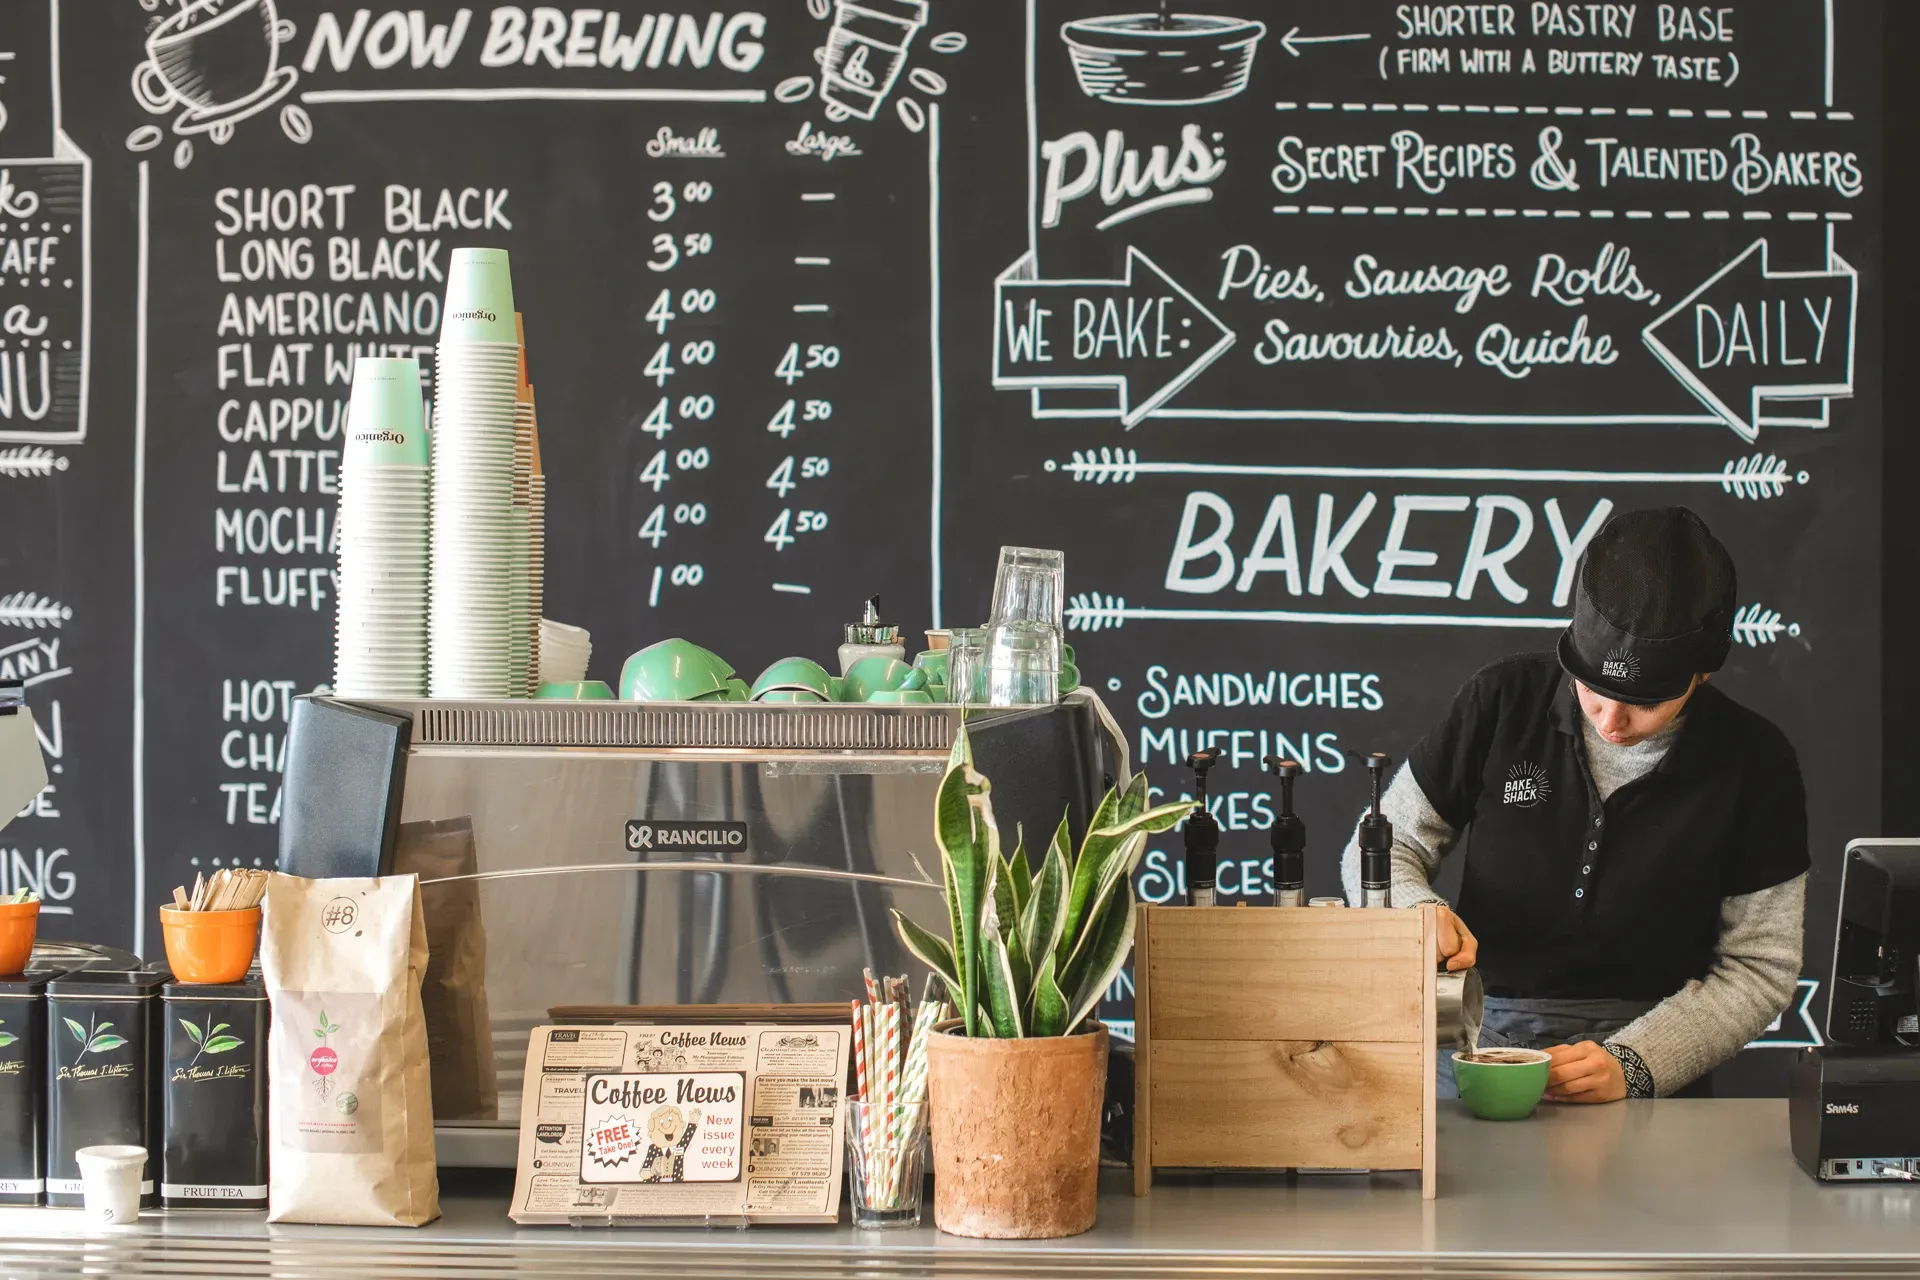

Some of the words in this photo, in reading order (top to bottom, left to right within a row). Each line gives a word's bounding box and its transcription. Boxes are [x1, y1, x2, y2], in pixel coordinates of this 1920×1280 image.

[302, 9, 472, 72] NOW
[480, 6, 767, 72] BREWING
[1396, 3, 1515, 38] SHORTER
[1532, 3, 1638, 39] PASTRY
[1658, 6, 1734, 42] BASE
[1460, 49, 1511, 73] WITH
[1522, 50, 1536, 73] A
[1548, 51, 1643, 77] BUTTERY
[646, 126, 721, 157] Small
[785, 121, 856, 161] Large
[1530, 126, 1580, 191] &
[1042, 124, 1226, 228] Plus:
[215, 184, 356, 235] SHORT
[385, 184, 512, 233] BLACK
[216, 237, 315, 282] LONG
[328, 237, 444, 282] BLACK
[1218, 244, 1325, 302] Pies,
[1345, 254, 1512, 314] Sausage
[1531, 242, 1661, 306] Rolls,
[217, 292, 440, 337] AMERICANO
[1005, 298, 1053, 362] WE
[1073, 297, 1191, 360] BAKE:
[1253, 318, 1464, 368] Savouries,
[1475, 314, 1619, 378] Quiche
[1697, 297, 1832, 369] DAILY
[217, 342, 314, 390] FLAT
[325, 342, 434, 387] WTE
[217, 449, 339, 494] LATTE
[1165, 491, 1613, 606] BAKERY
[1602, 669, 1628, 678] SHACK
[1603, 661, 1625, 670] BAKE
[222, 679, 296, 723] HOT
[1137, 665, 1384, 719] SANDWICHES
[1139, 726, 1346, 774] MUFFINS
[1503, 789, 1537, 804] SHACK
[1504, 778, 1532, 792] BAKE
[1148, 787, 1275, 833] KES
[657, 830, 743, 845] RANCILIO
[1138, 850, 1275, 904] SLCES
[326, 906, 354, 926] #8
[660, 1031, 706, 1048] Coffee
[710, 1032, 746, 1046] News
[56, 1066, 71, 1079] Sir
[172, 1068, 187, 1081] Sir
[591, 1079, 667, 1109] Coffee
[676, 1078, 736, 1105] News
[596, 1124, 630, 1145] FREE
[703, 1129, 735, 1140] issue
[706, 1115, 733, 1125] New
[598, 1145, 615, 1155] Take
[618, 1141, 635, 1150] One!
[702, 1146, 735, 1157] every
[702, 1158, 733, 1168] week
[65, 1183, 84, 1191] GR
[183, 1187, 217, 1197] FRUIT
[220, 1188, 244, 1197] TEA
